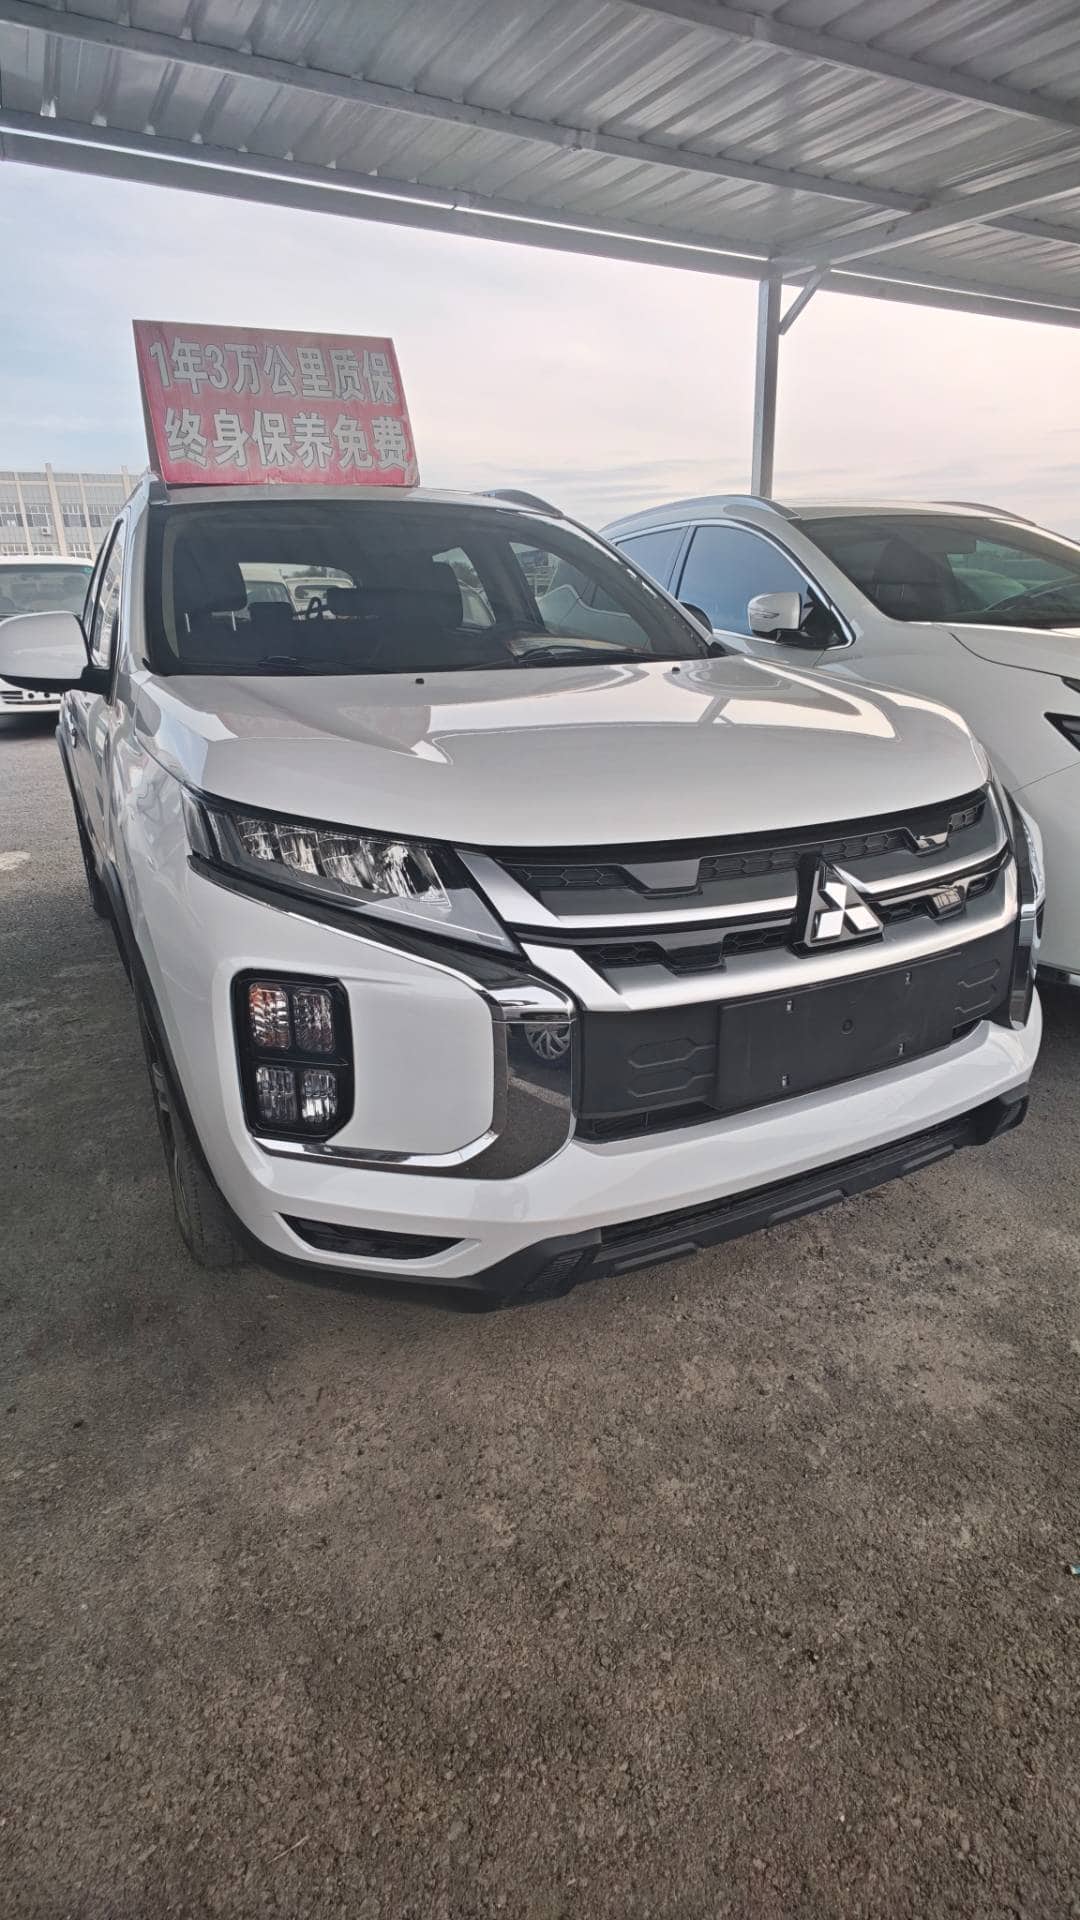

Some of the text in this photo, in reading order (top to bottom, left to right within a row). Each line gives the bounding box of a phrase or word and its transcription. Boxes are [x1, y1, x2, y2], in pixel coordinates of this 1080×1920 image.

[149, 337, 398, 404] 1年3万公里质保
[163, 407, 409, 470] 终身保养免费
